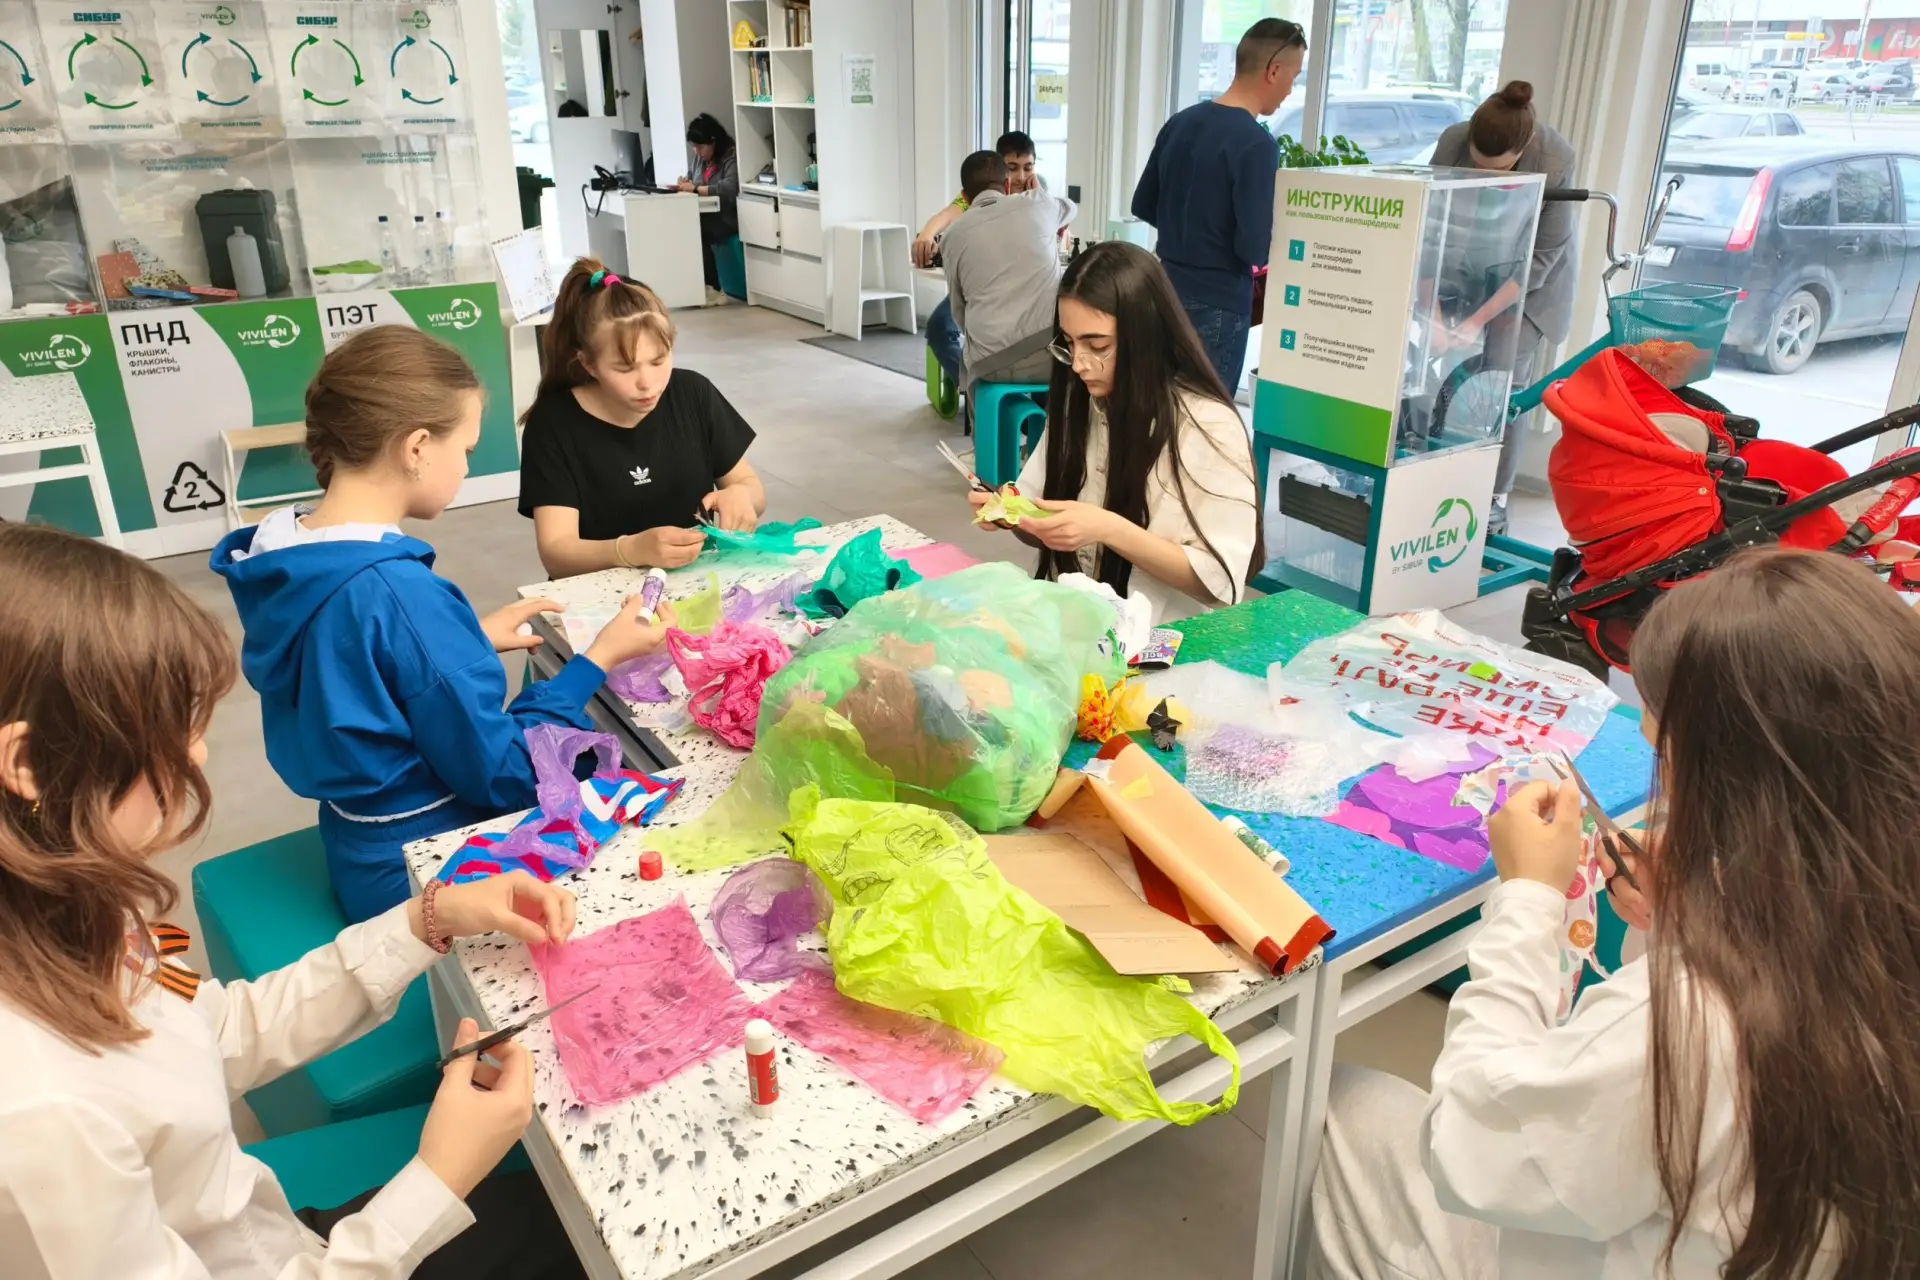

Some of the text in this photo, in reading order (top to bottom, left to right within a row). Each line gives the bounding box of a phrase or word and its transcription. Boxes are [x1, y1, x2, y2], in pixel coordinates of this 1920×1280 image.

[73, 13, 121, 22] СИБУР
[296, 16, 338, 25] СИБУР
[1286, 188, 1404, 219] ИНСТРУКЦИЯ
[1298, 210, 1344, 223] пользоваться
[1294, 246, 1299, 256] 1
[1313, 242, 1362, 256] Положи крышки
[1289, 290, 1295, 300] 2
[1327, 293, 1350, 302] крутить
[1307, 298, 1372, 315] перемалывая крышки
[327, 303, 378, 327] ПЭТ
[427, 311, 470, 322] VIVILEN
[121, 320, 191, 346] ПНД
[238, 328, 287, 341] VIVILEN
[1285, 334, 1291, 344] 3
[1304, 333, 1375, 354] Получившийся материал
[19, 347, 76, 362] VIVILEN
[127, 348, 170, 358] КРЫШКИ,
[1327, 348, 1356, 360] инженеру
[1356, 354, 1368, 362] для
[129, 357, 178, 367] ФЛАКОНЫ,
[1340, 360, 1365, 370] изделия
[131, 366, 181, 377] КАНИСТРЫ
[184, 481, 200, 499] 2
[1390, 527, 1459, 561] VIVILEN
[1392, 559, 1423, 575] BY SIBUR
